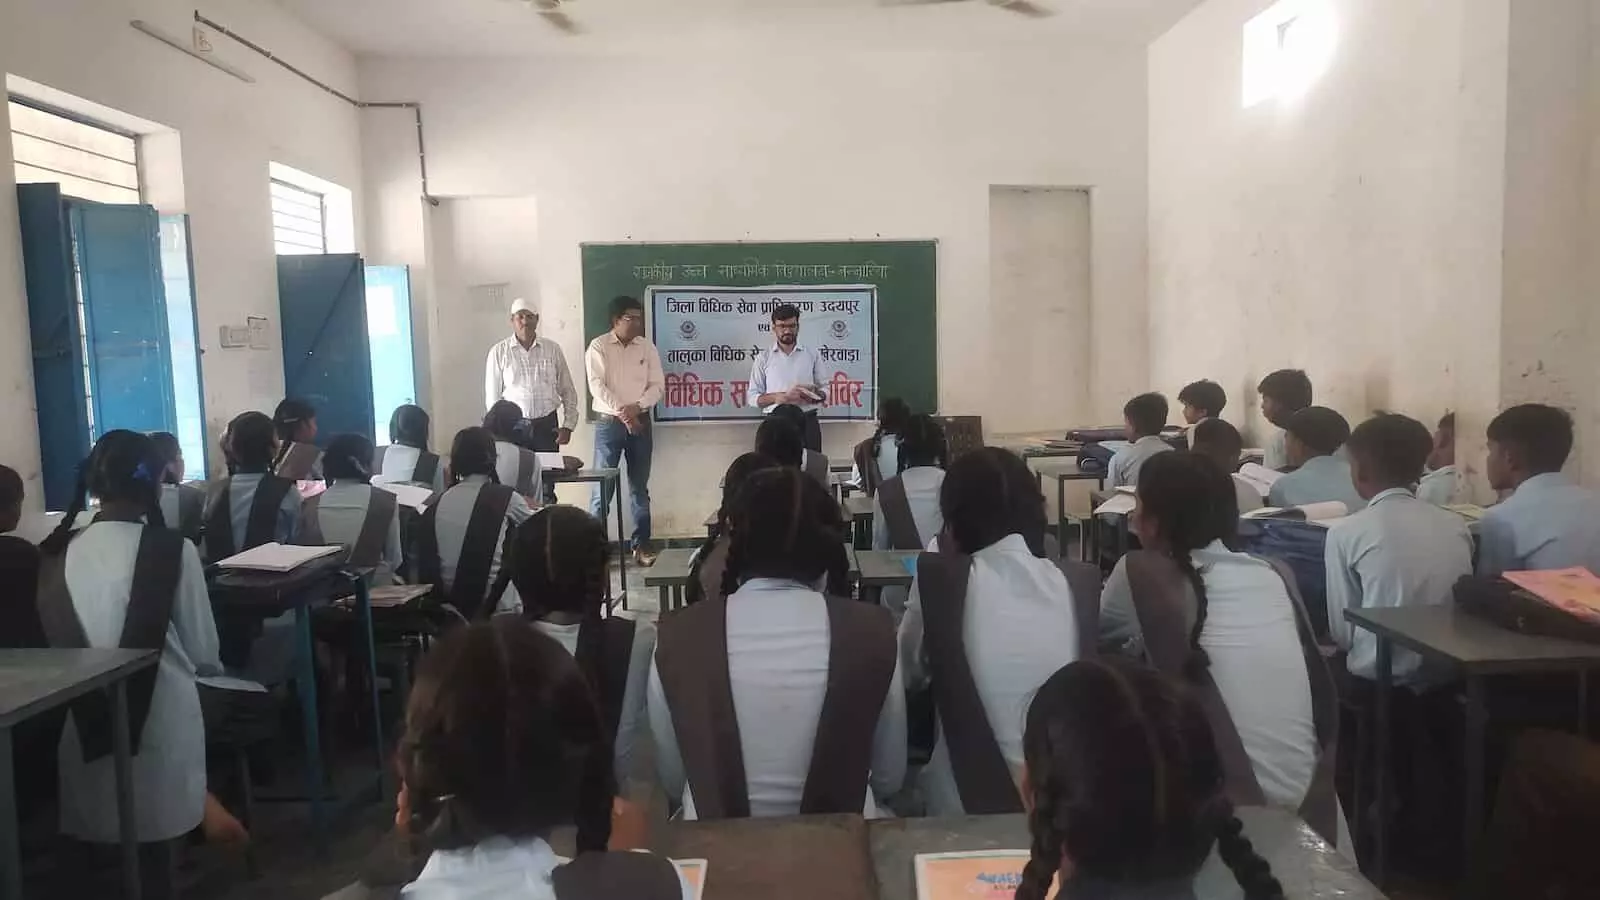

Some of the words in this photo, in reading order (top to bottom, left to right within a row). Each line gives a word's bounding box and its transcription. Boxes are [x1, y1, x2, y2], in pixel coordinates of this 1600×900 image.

[666, 297, 696, 314] जिला
[699, 297, 733, 314] विधिक
[737, 298, 757, 315] सेवा
[820, 299, 861, 315] उदयपुर
[668, 349, 706, 366] तालुका
[710, 345, 746, 363] विधिक
[664, 372, 724, 408] विधिक
